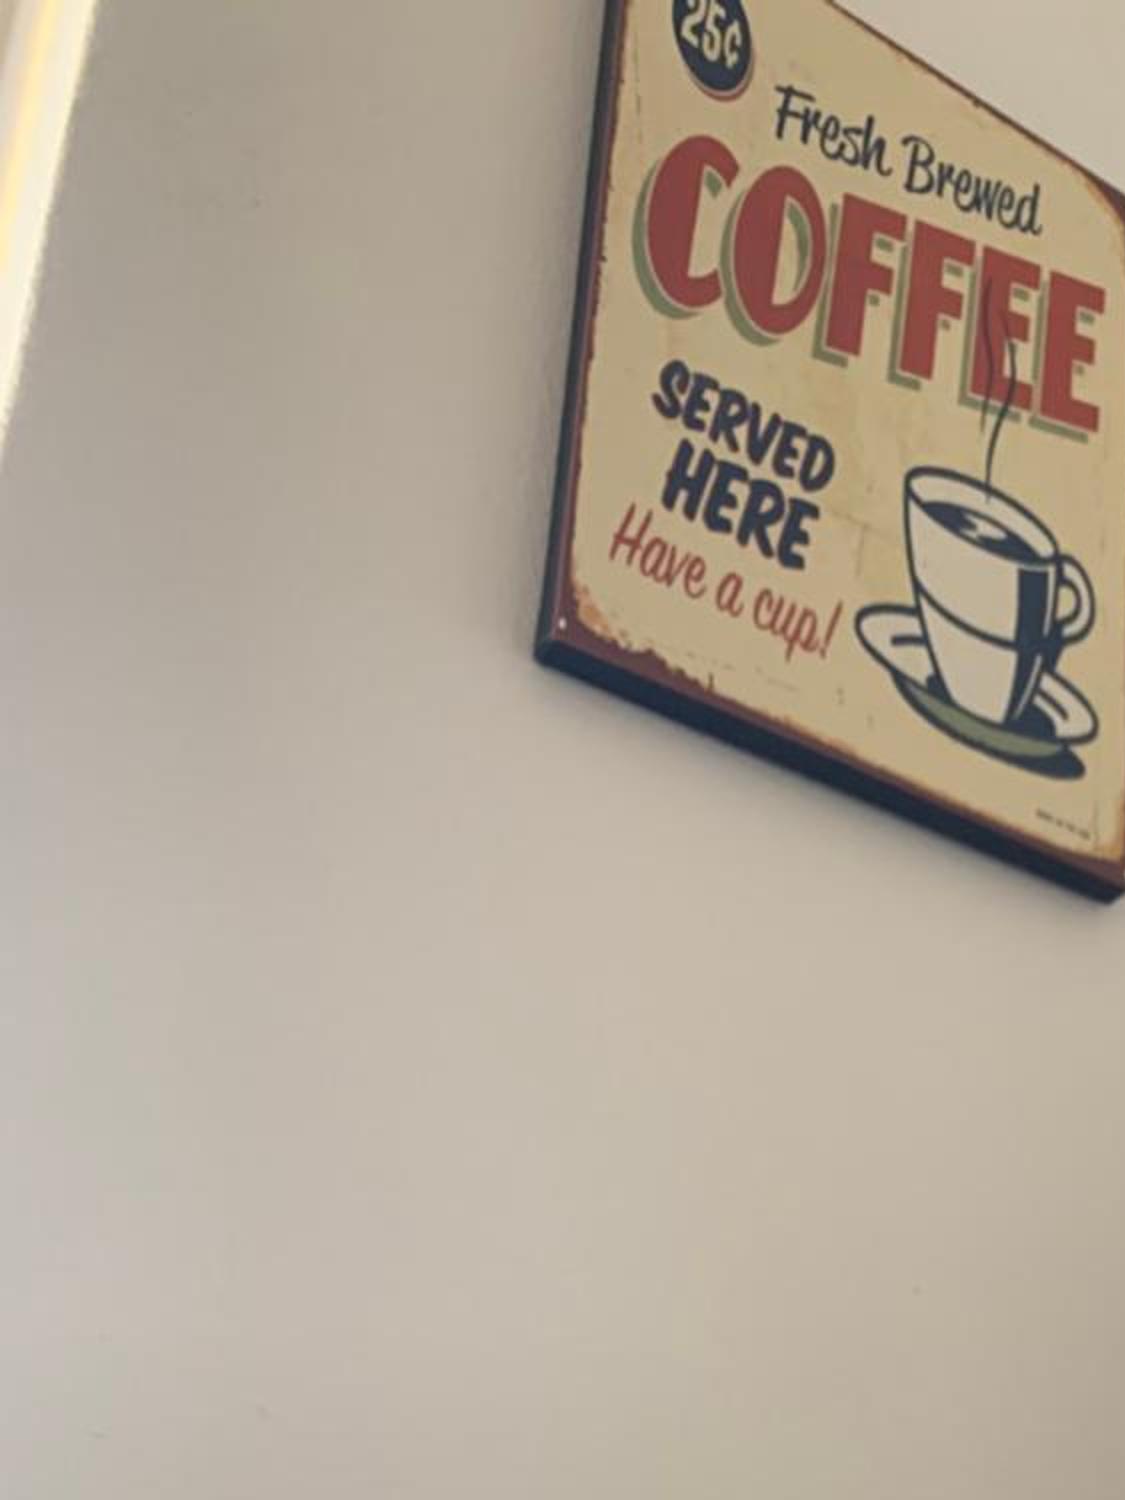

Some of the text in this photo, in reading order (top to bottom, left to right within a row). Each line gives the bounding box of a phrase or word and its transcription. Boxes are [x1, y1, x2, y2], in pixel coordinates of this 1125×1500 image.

[775, 85, 1042, 235] Fresh Brewed
[633, 134, 1106, 441] COFFEE
[651, 359, 835, 492] SERVED
[660, 439, 820, 570] HERE
[608, 503, 843, 663] Have a cup!
